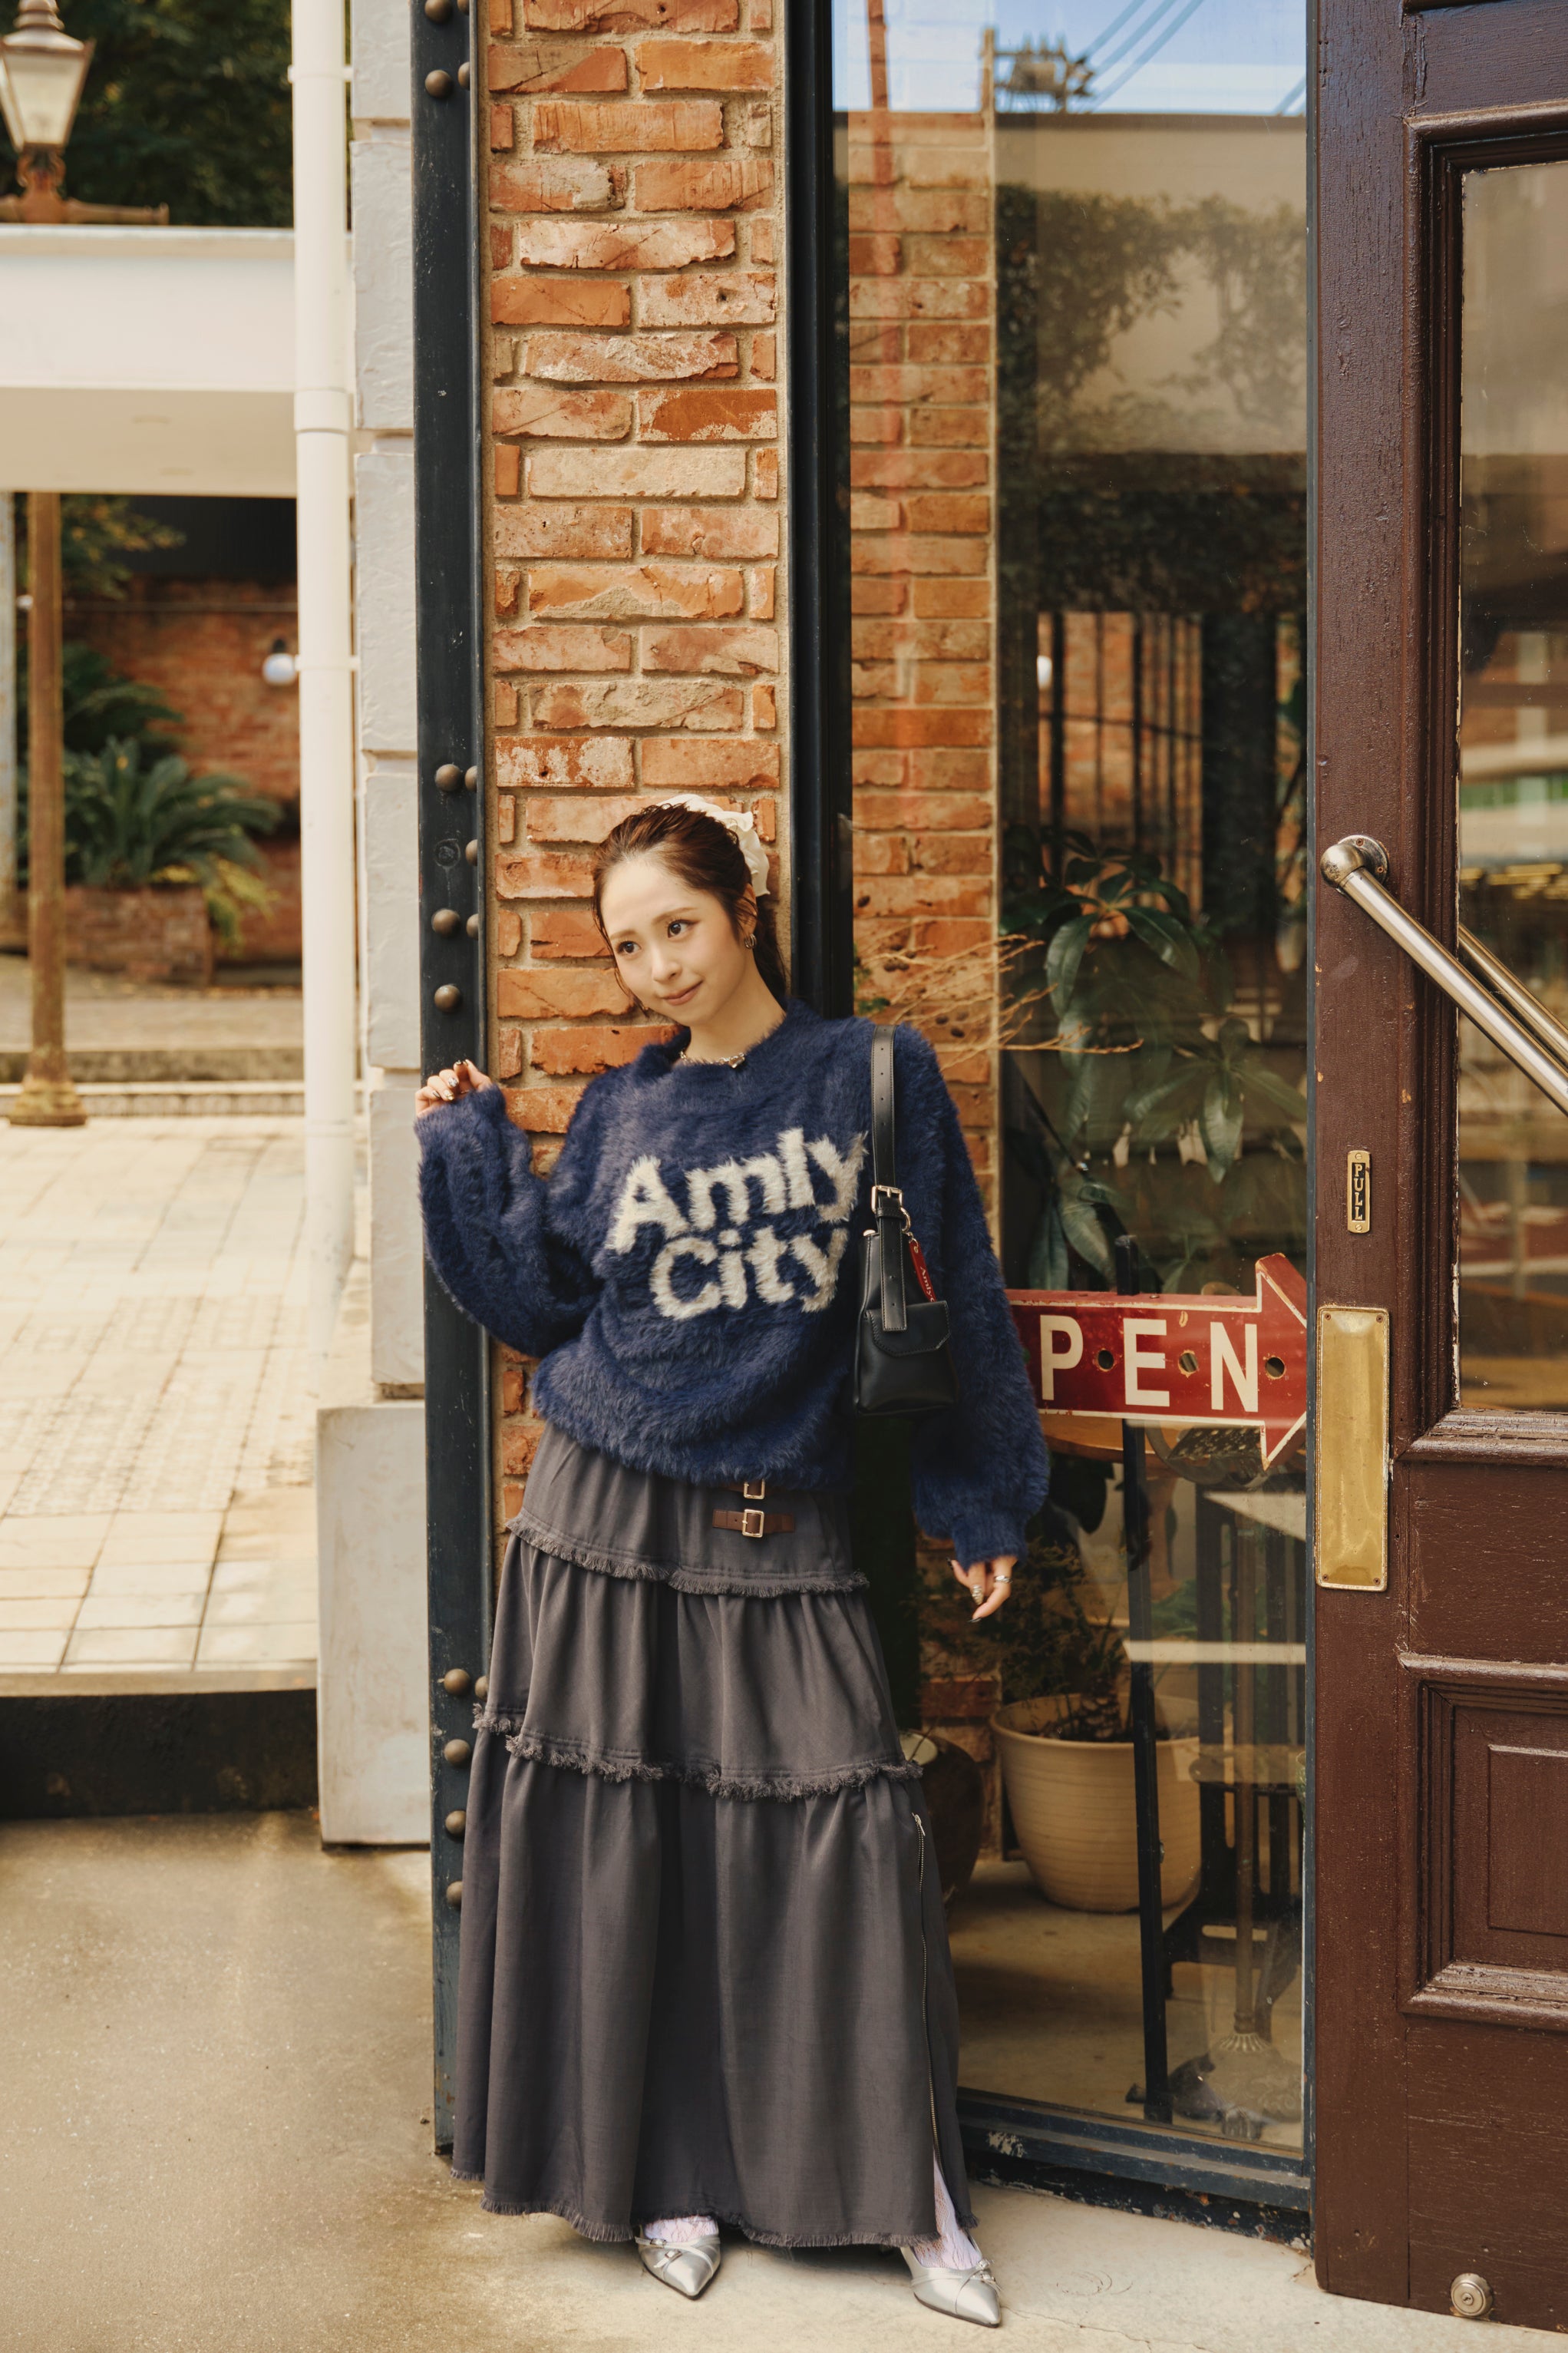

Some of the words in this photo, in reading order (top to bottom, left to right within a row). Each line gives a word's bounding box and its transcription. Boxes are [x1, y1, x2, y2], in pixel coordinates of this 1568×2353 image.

[606, 1127, 868, 1255] Amly
[1353, 1163, 1364, 1221] PULL
[649, 1225, 848, 1320] City
[1040, 1314, 1259, 1413] PEN
